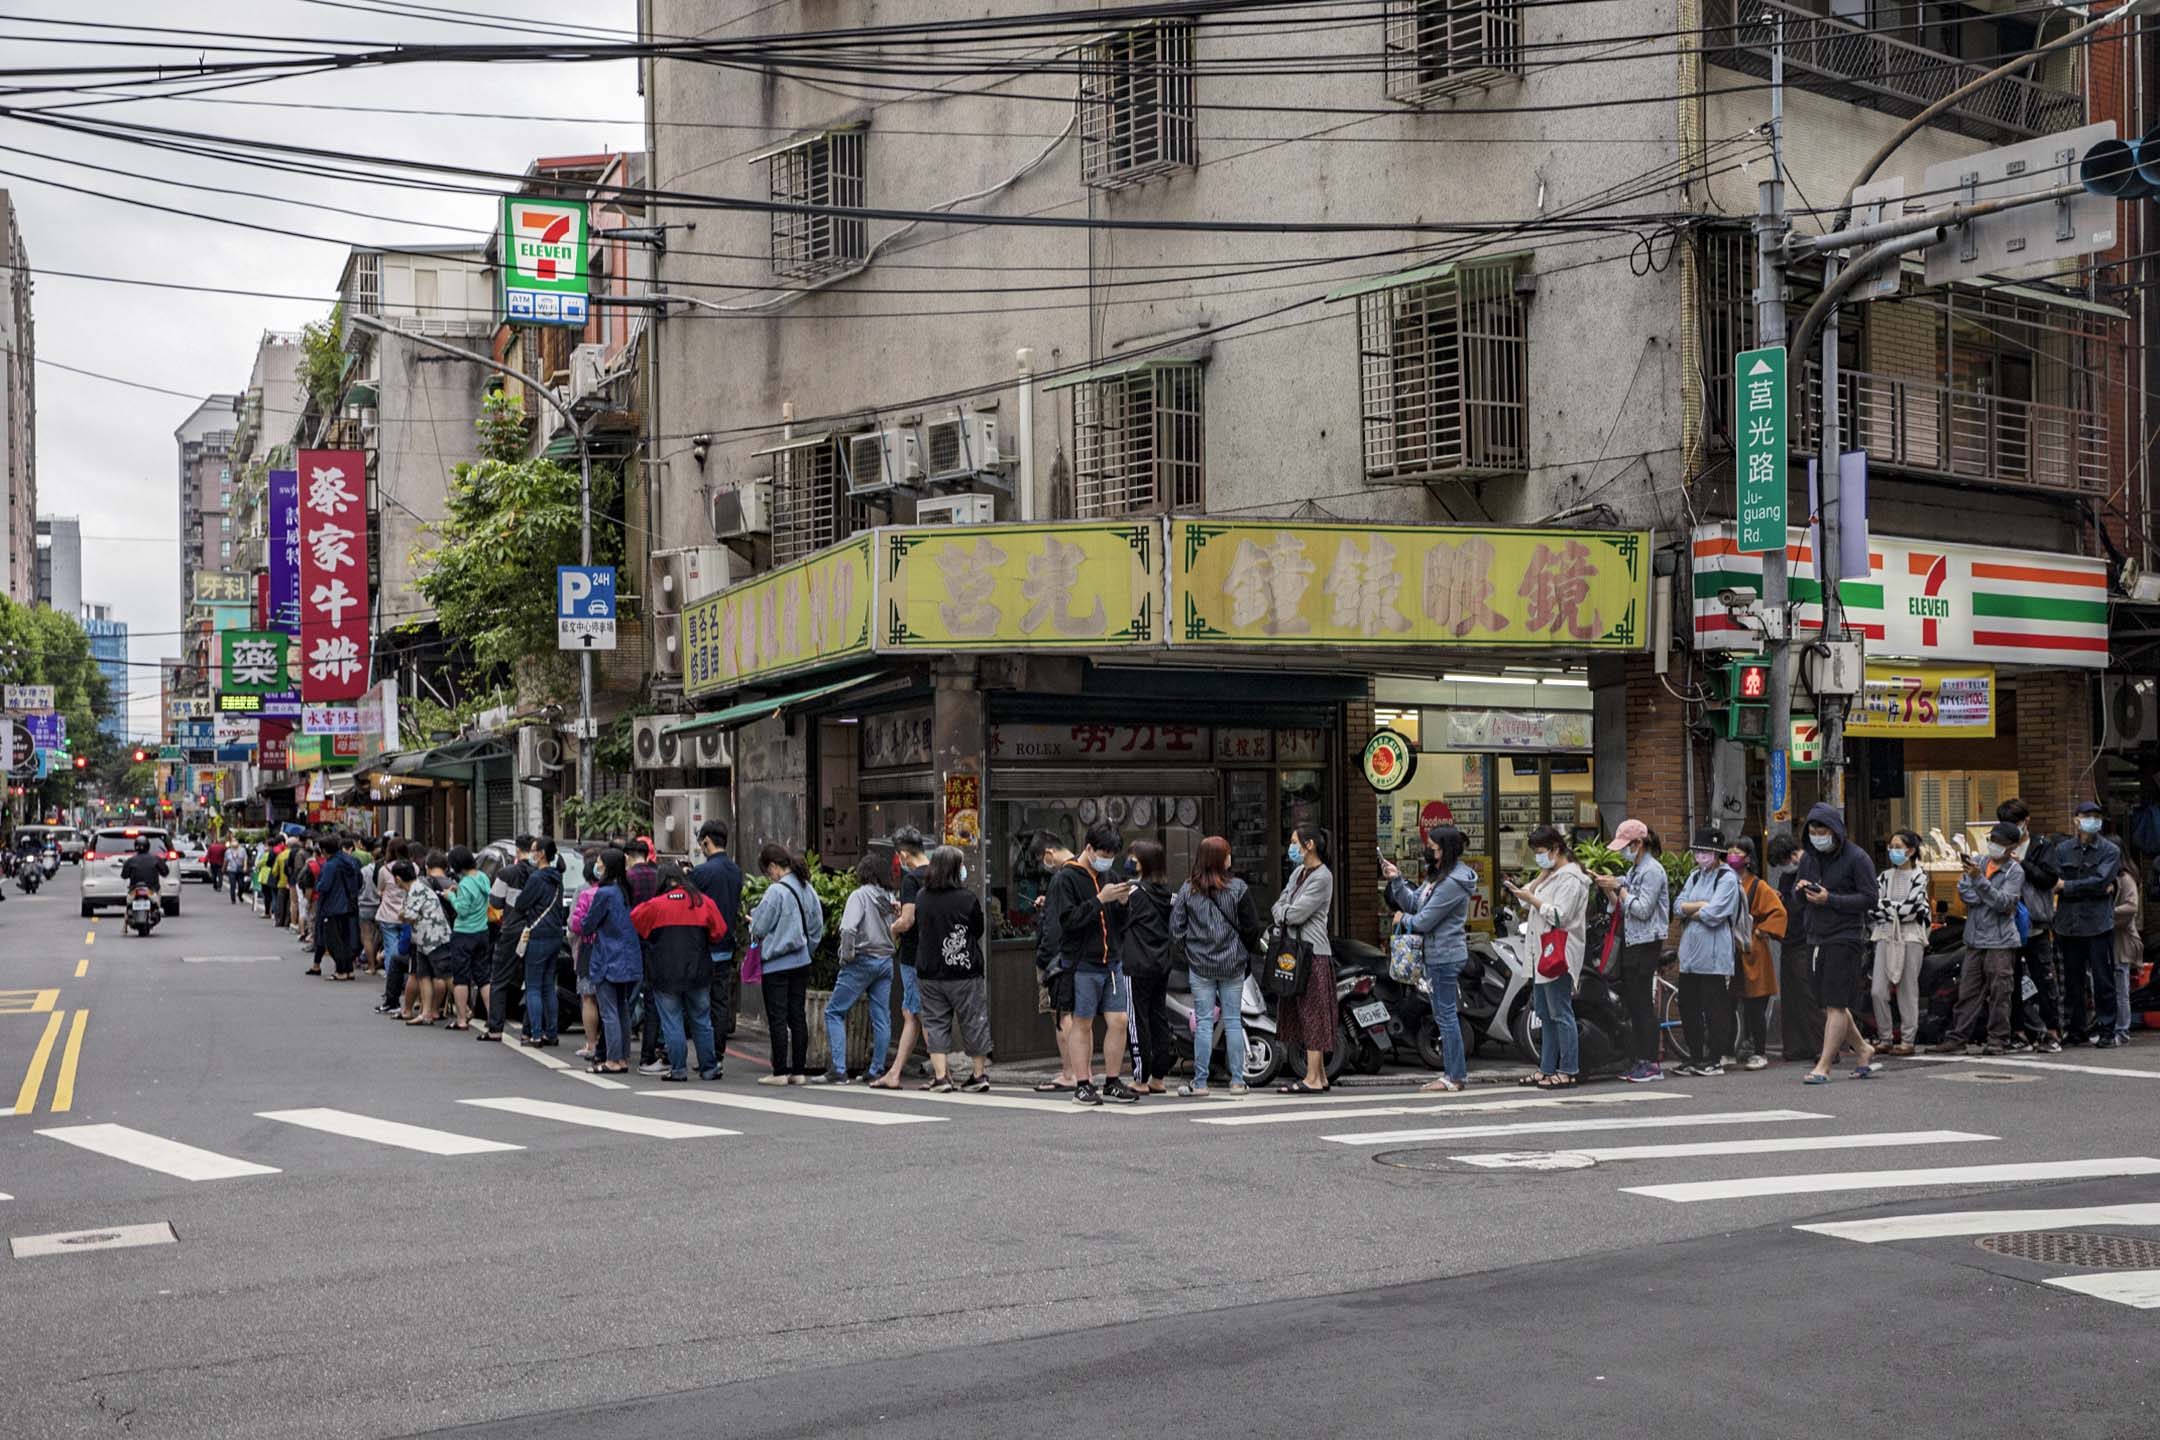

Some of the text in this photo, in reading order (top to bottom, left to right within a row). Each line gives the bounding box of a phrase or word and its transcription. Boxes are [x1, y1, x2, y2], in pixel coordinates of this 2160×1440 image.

[512, 295, 530, 303] ATM
[1748, 379, 1775, 484] 莒光路
[1744, 491, 1763, 505] Ju-
[1744, 505, 1781, 524] guang
[1744, 528, 1763, 543] Rd.
[306, 467, 362, 684] 蔡家牛排
[592, 573, 610, 586] 24H
[201, 576, 246, 599] 牙科
[561, 572, 592, 615] P
[232, 639, 278, 685] 藥
[1903, 678, 1935, 723] 75
[307, 711, 369, 727] 水電修
[1016, 743, 1062, 756] ROLEX
[1471, 895, 1490, 918] 75
